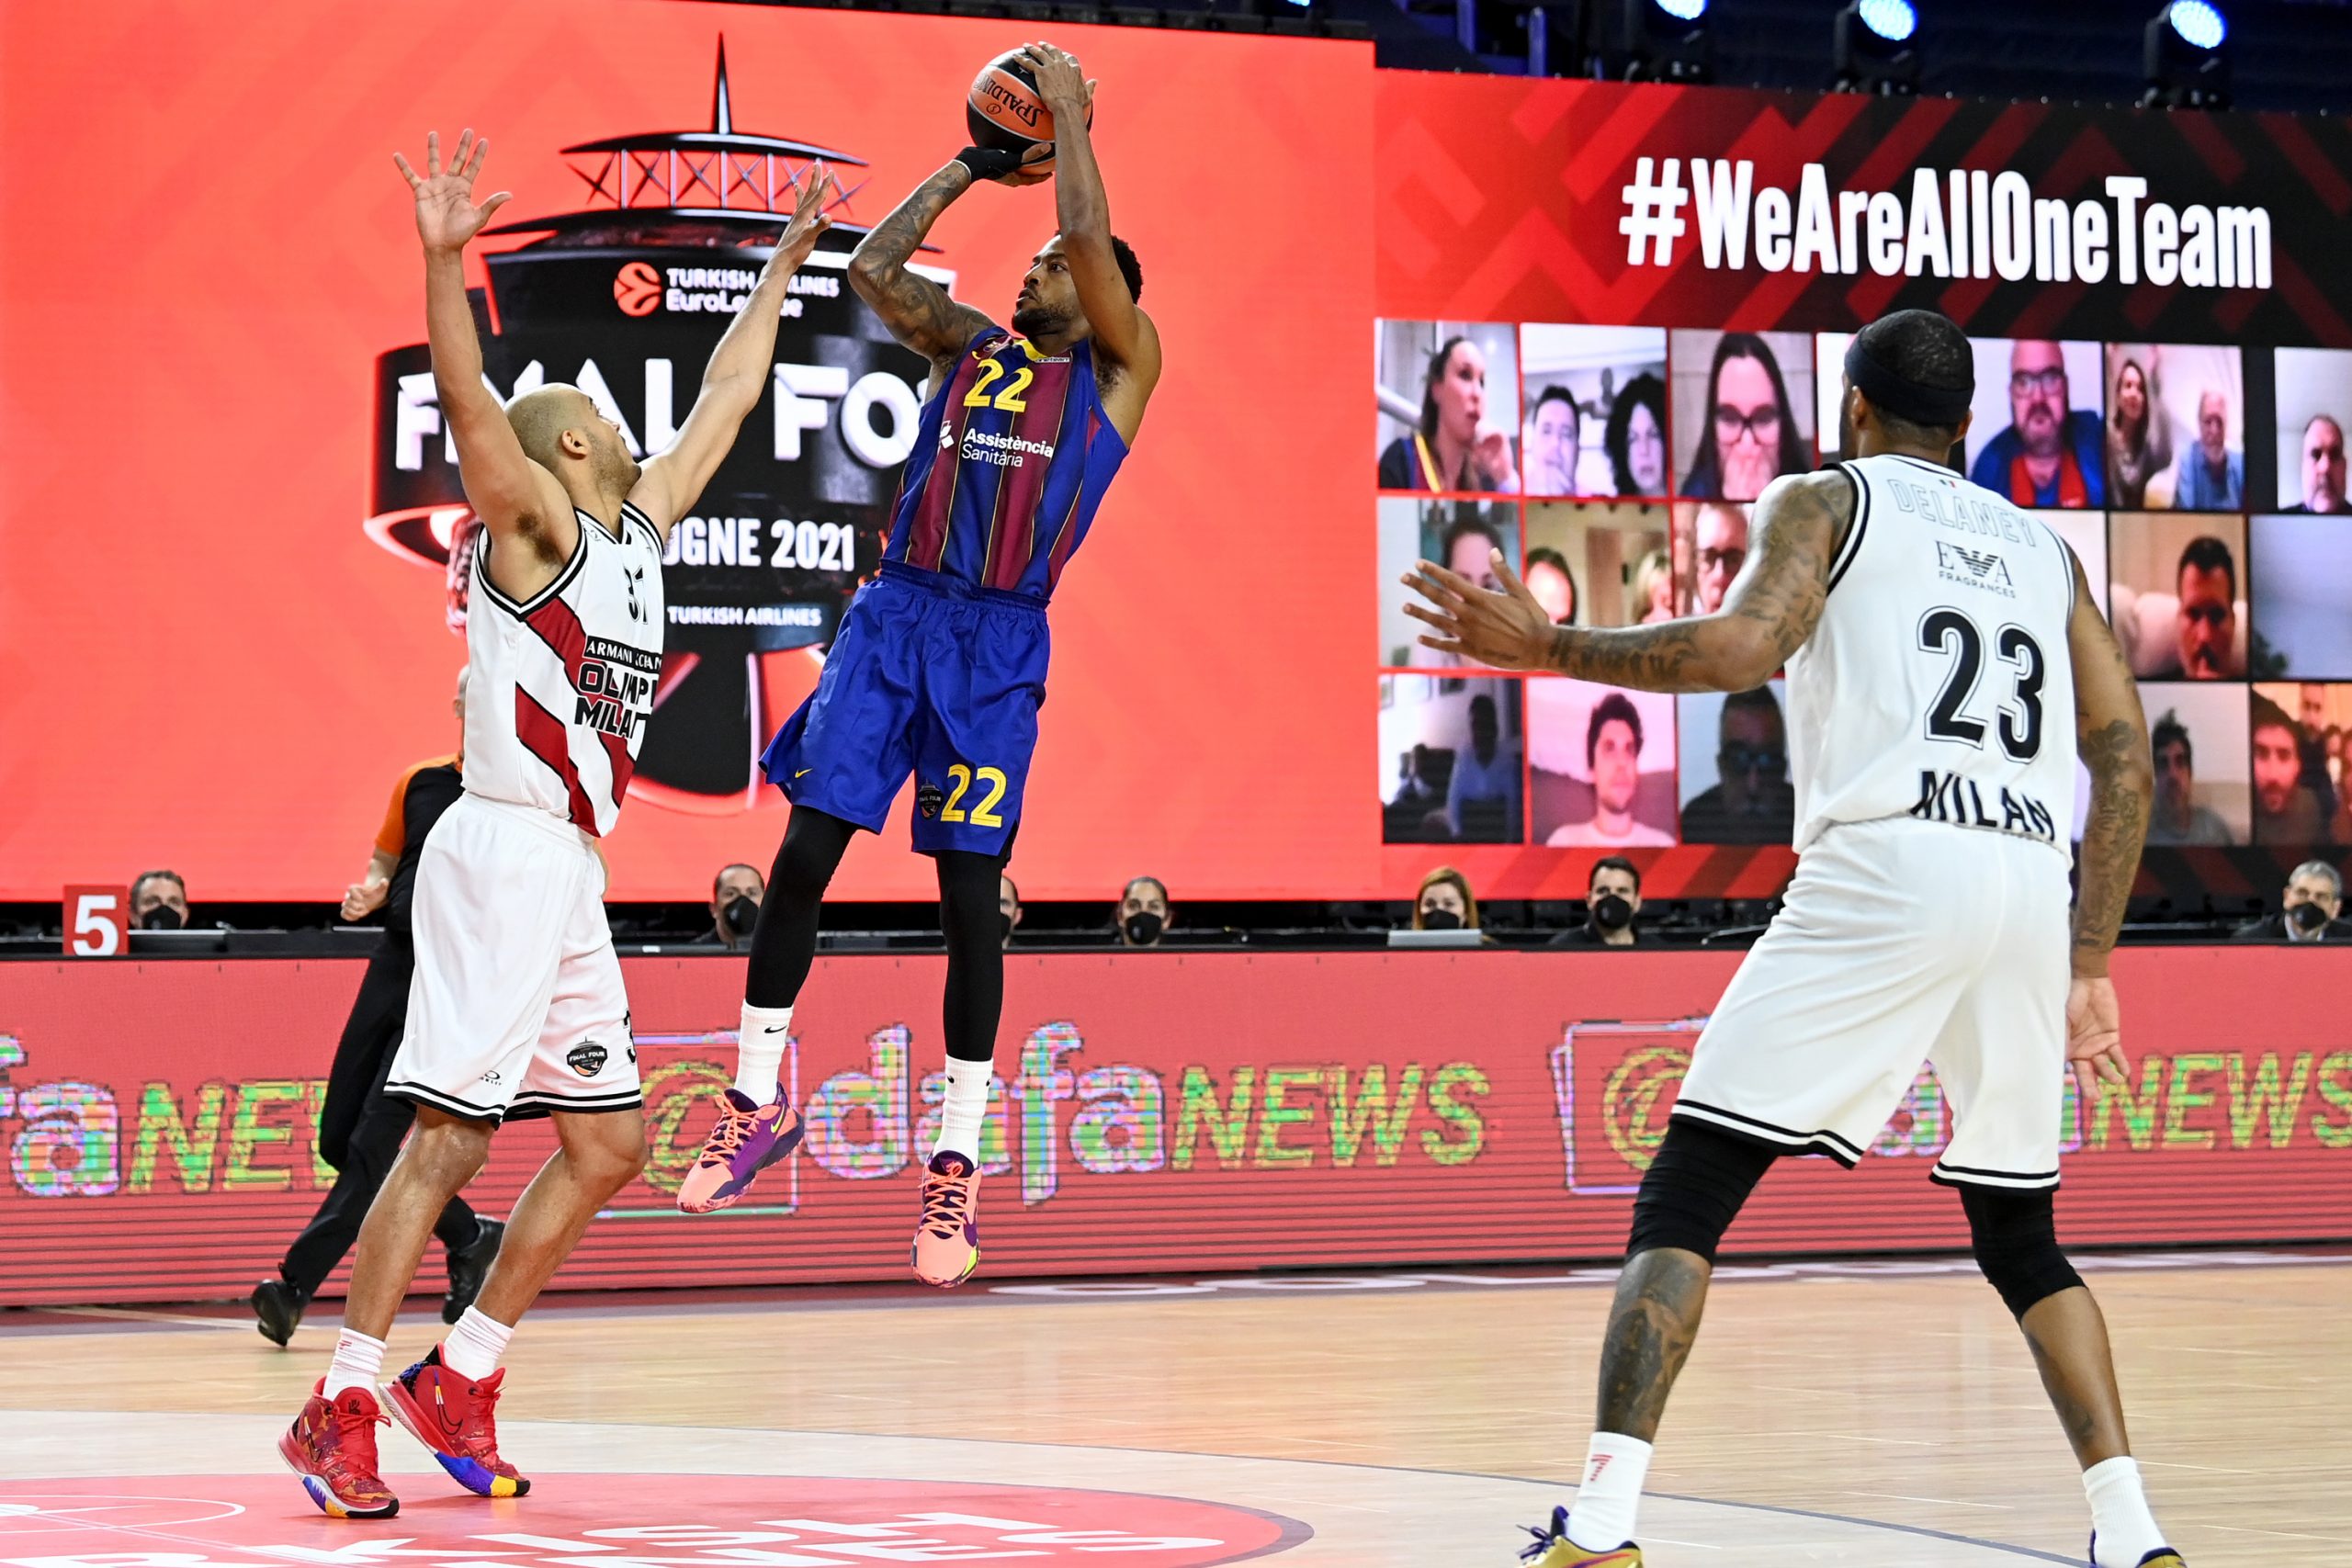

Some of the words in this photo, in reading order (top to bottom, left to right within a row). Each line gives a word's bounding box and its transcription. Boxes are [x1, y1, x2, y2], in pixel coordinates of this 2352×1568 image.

[1619, 156, 2272, 289] #WeAreAllOneTeam
[666, 267, 755, 289] TURKISH
[963, 357, 1035, 413] 22
[961, 444, 1024, 468] Sanitària
[964, 427, 1055, 458] Assistència
[1887, 479, 2038, 547] DELANEY
[770, 519, 855, 572] 2021
[1939, 570, 2017, 599] FRAGRANCES
[667, 605, 743, 626] TURKISH
[744, 606, 823, 626] AIRLINES
[585, 639, 633, 664] ARMANI
[1917, 605, 2047, 764] 23
[940, 763, 1008, 828] 22
[72, 896, 119, 956] 5
